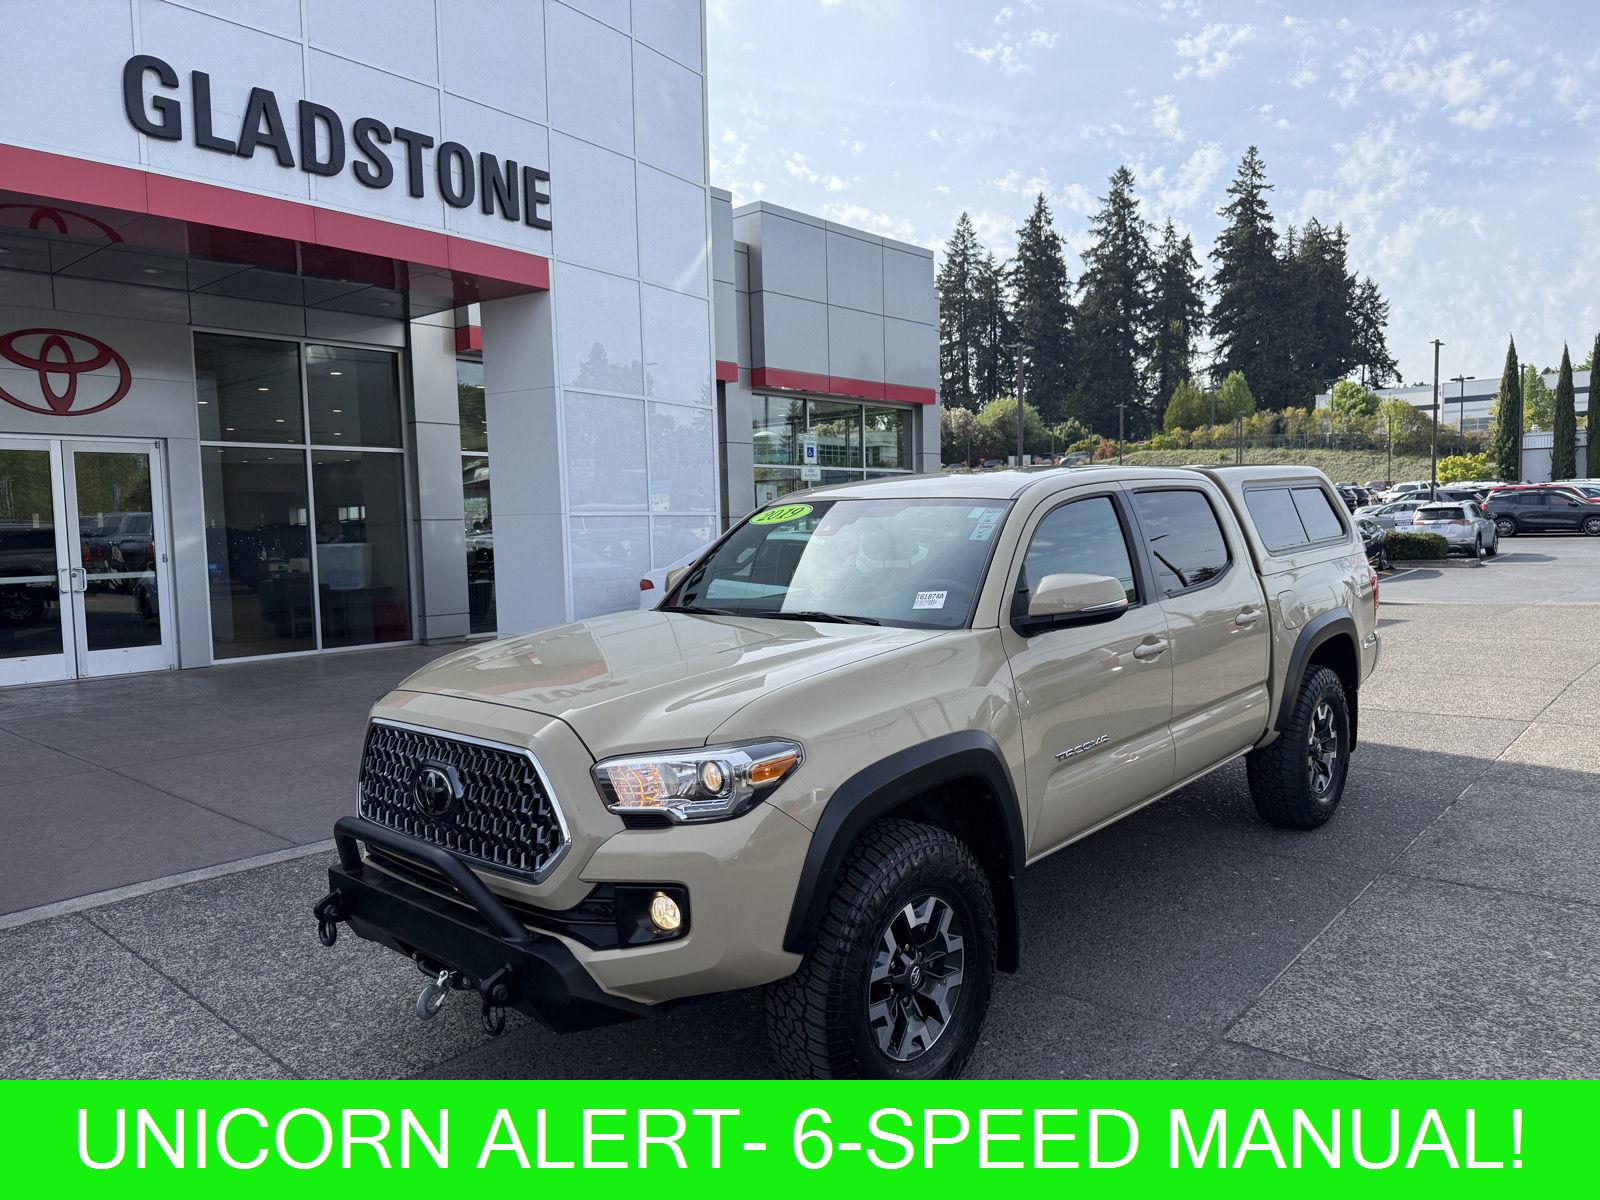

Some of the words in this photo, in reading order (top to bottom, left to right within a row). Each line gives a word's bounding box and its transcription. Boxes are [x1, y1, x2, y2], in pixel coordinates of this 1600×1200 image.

[123, 54, 553, 231] GLADSTONE
[756, 506, 805, 521] 2019
[1055, 734, 1110, 761] TACOMA
